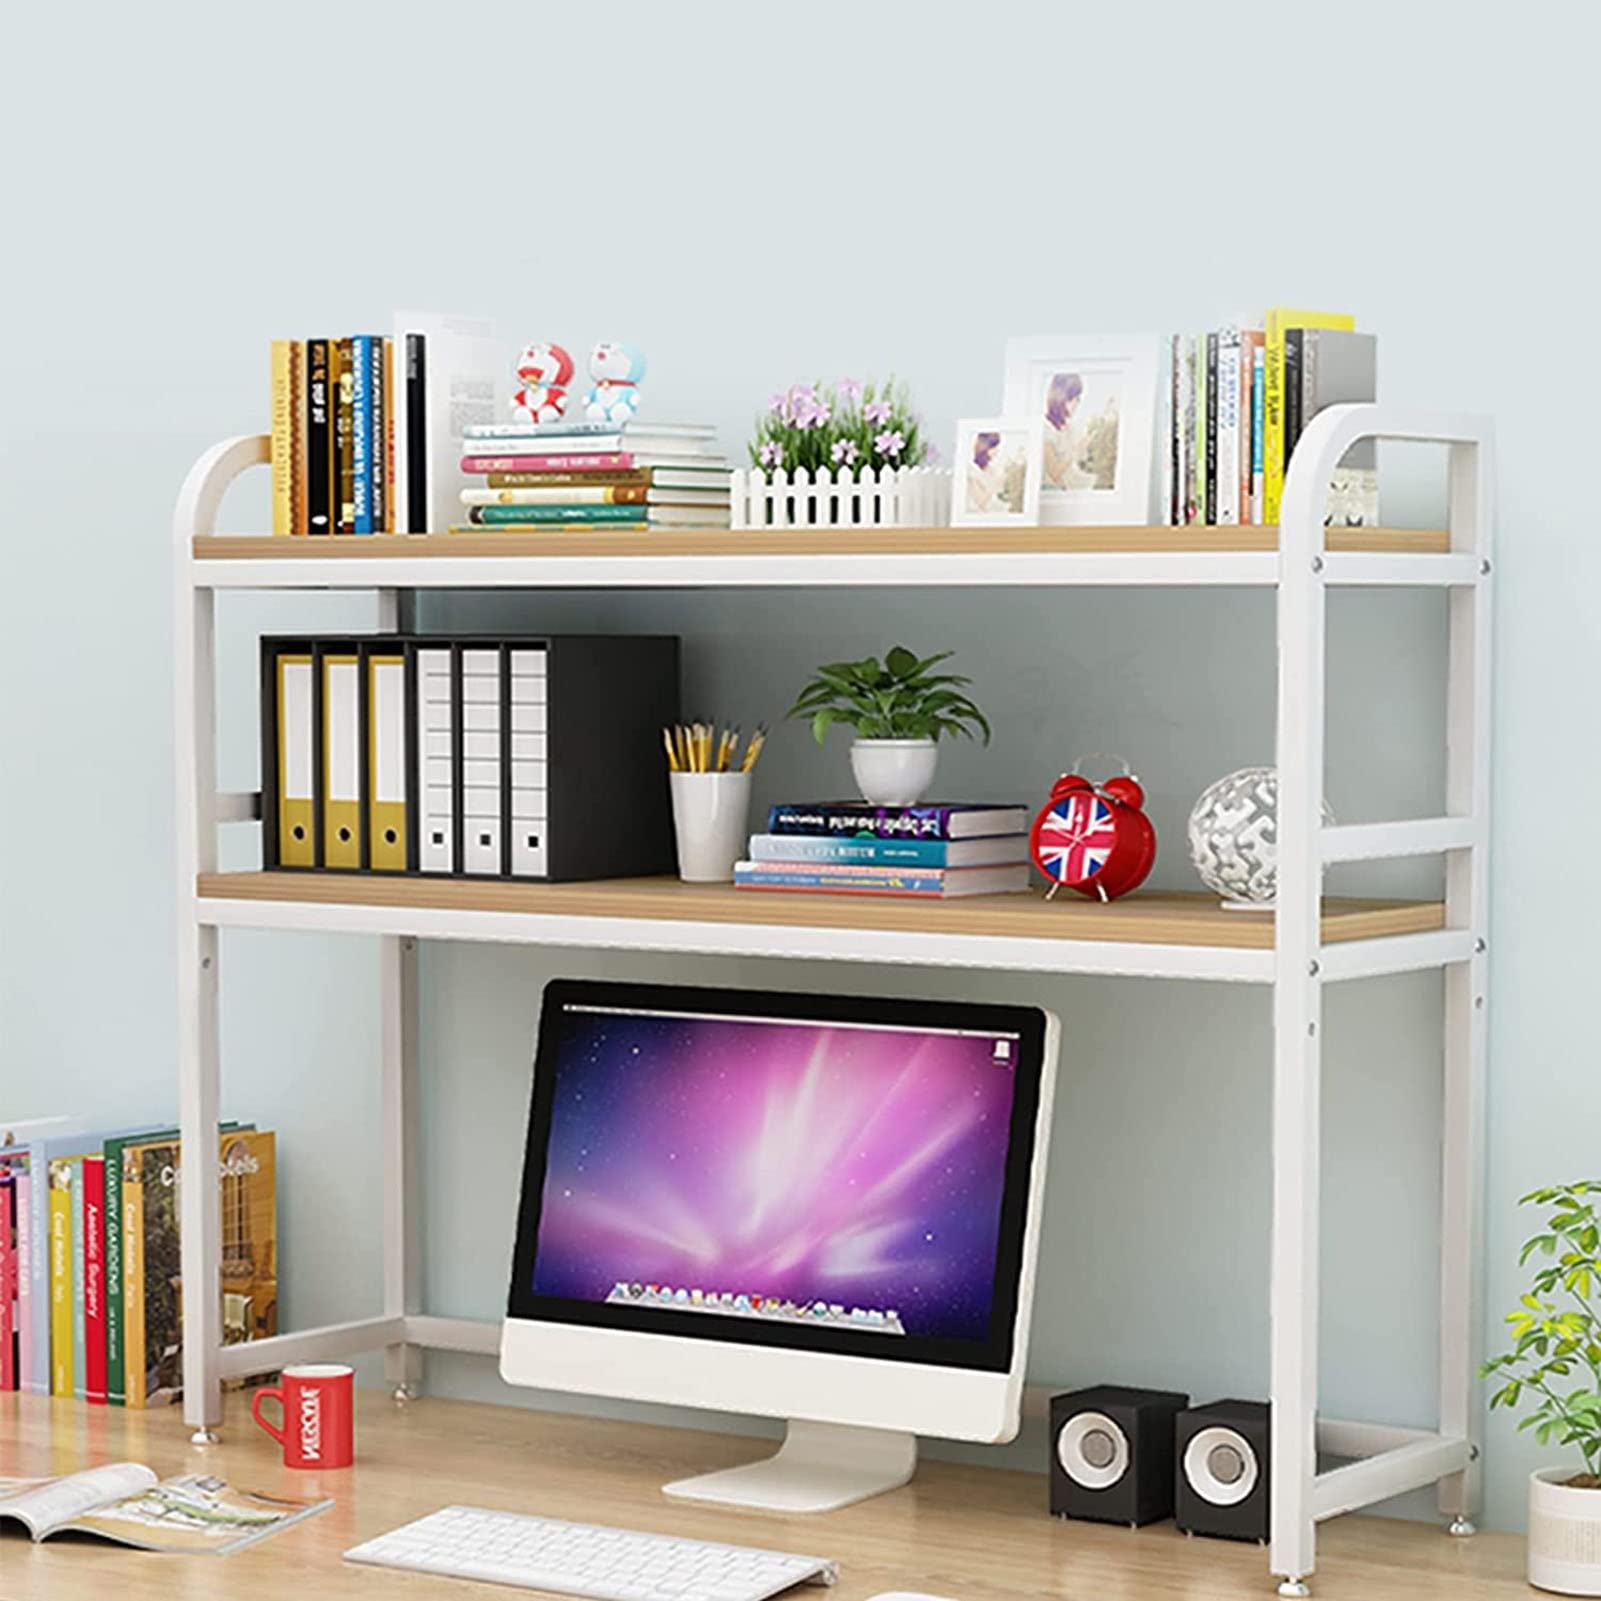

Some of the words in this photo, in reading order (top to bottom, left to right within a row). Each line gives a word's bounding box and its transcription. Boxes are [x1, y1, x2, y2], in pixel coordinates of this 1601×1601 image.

[106, 1159, 119, 1217] LUXURY
[107, 1222, 119, 1295] GARDENS
[87, 1263, 99, 1318] Surgery
